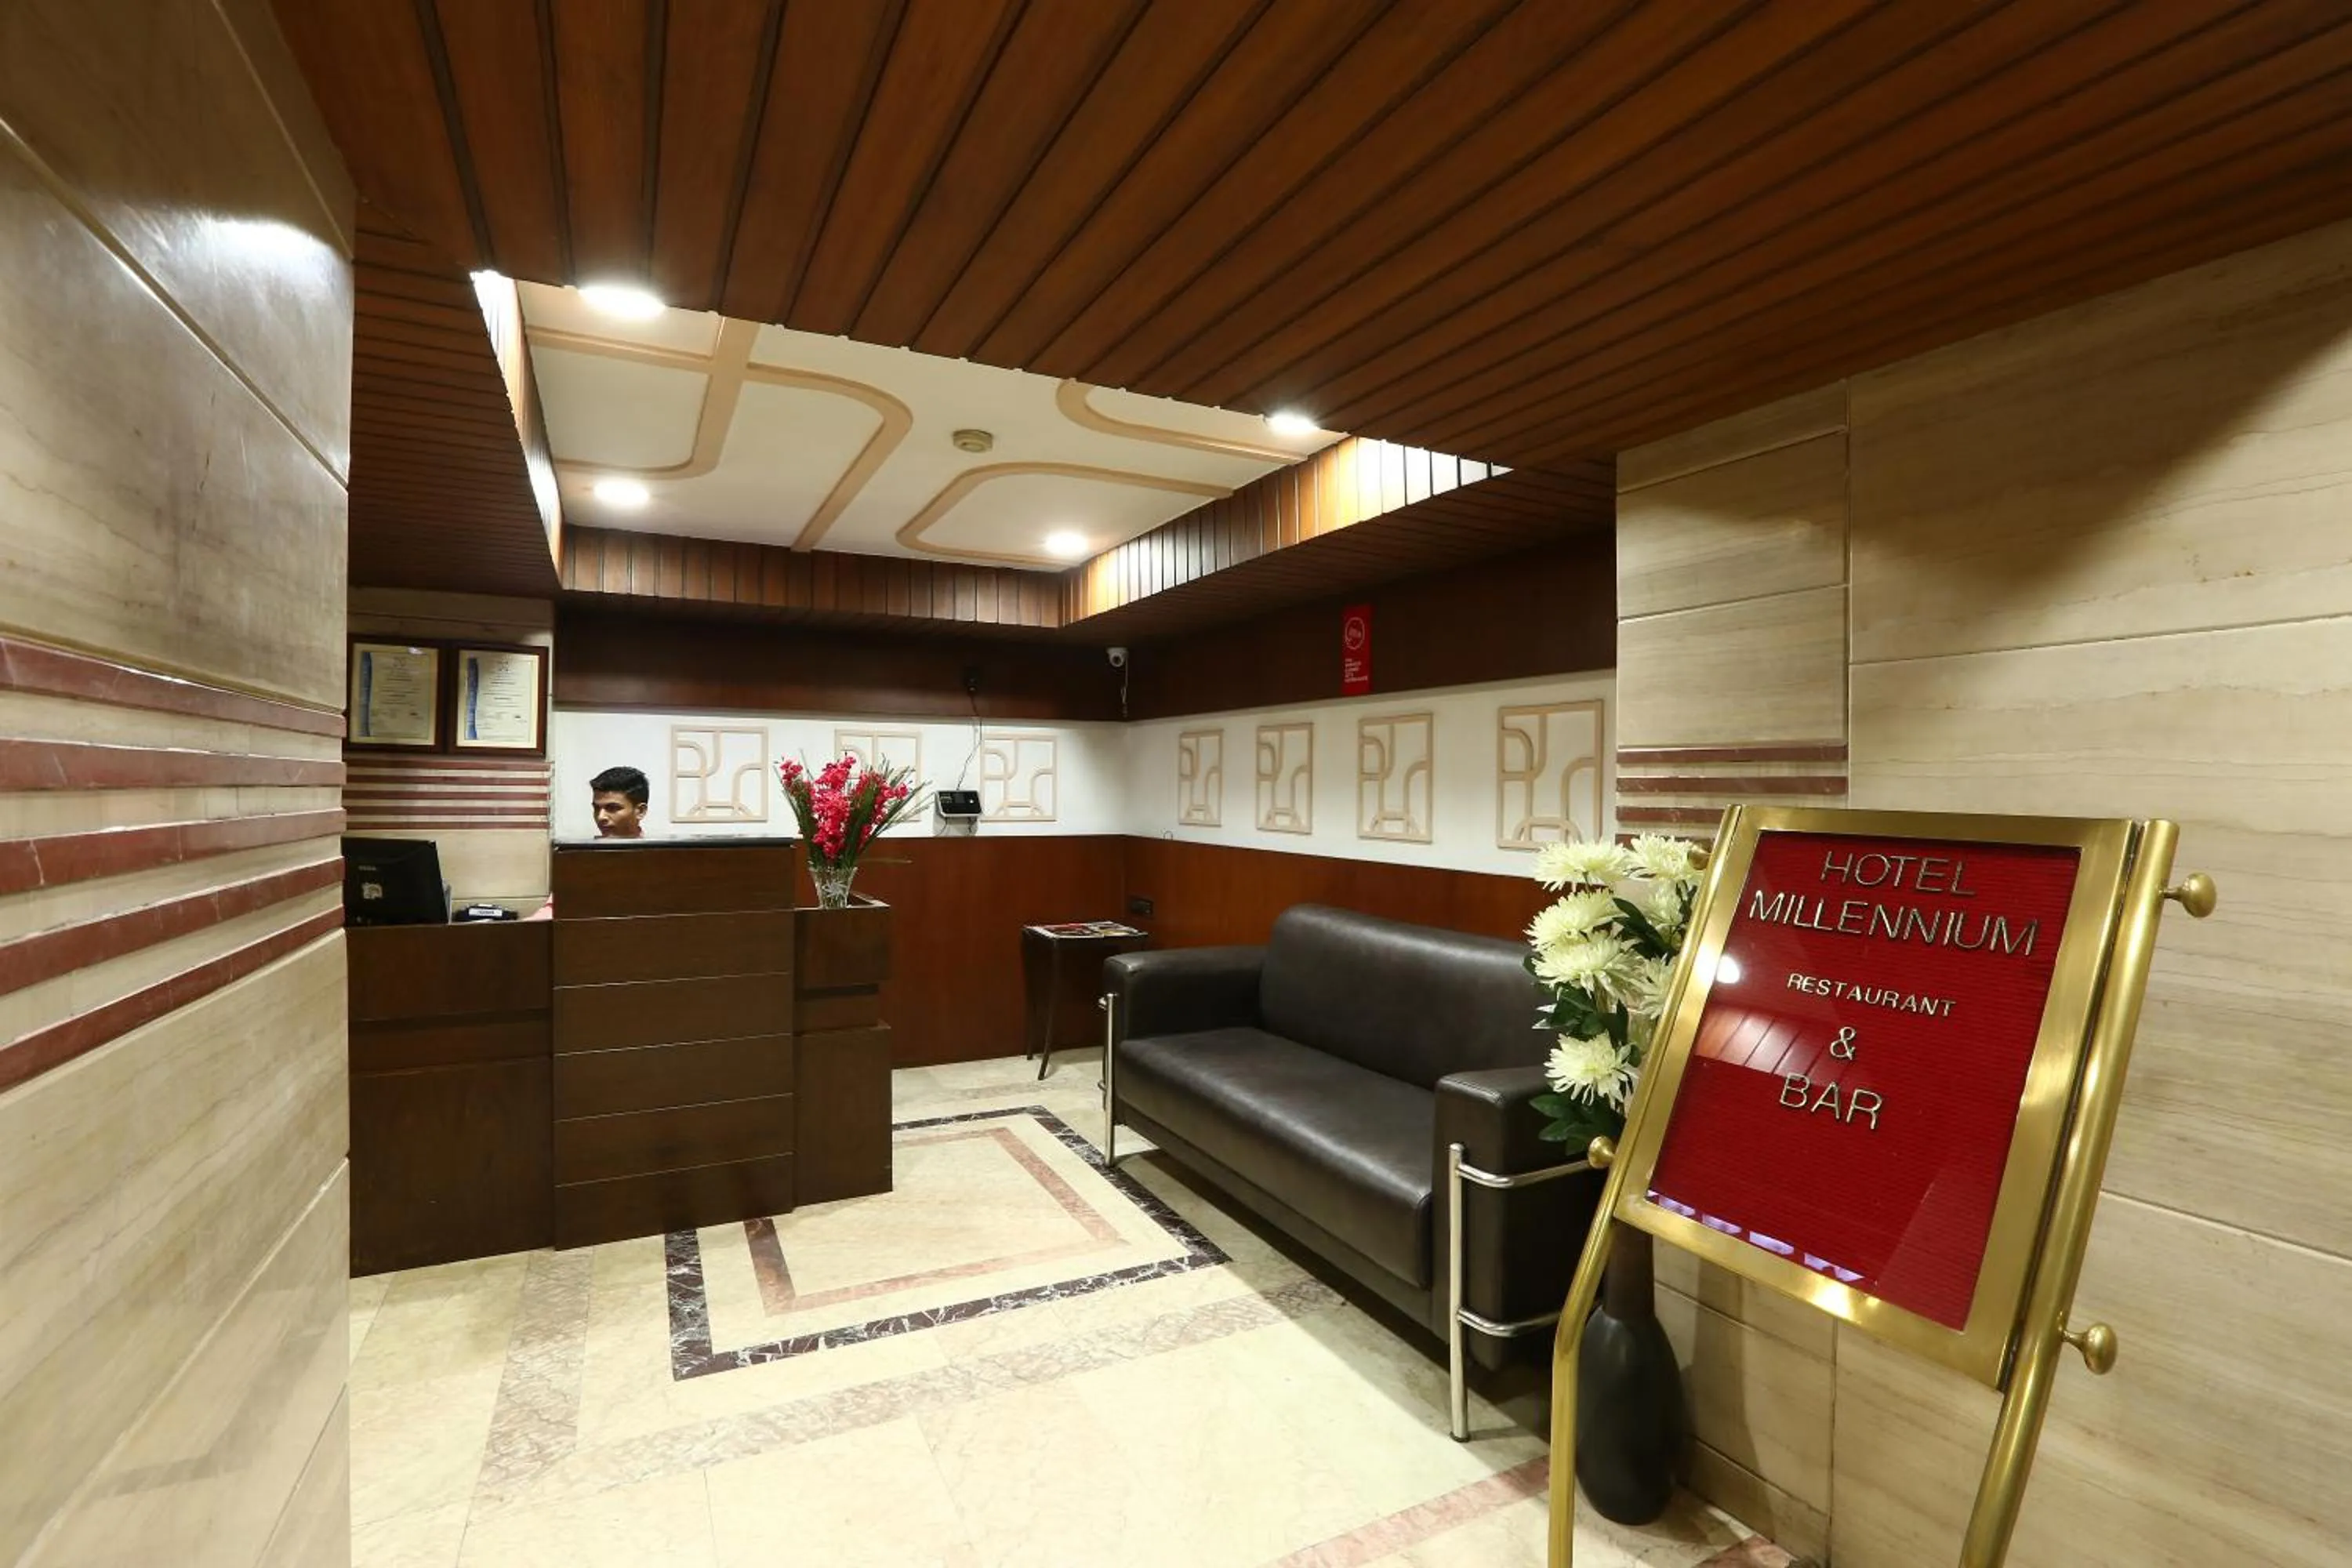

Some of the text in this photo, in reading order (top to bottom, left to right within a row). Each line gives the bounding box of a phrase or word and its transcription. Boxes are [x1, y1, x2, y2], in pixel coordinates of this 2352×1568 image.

[1819, 851, 1976, 895] HOTEL
[1749, 889, 2038, 956] MILLENNIUM
[1787, 972, 1957, 1017] RESTAURANT
[1829, 1026, 1857, 1060] &
[1779, 1072, 1883, 1130] BAR
